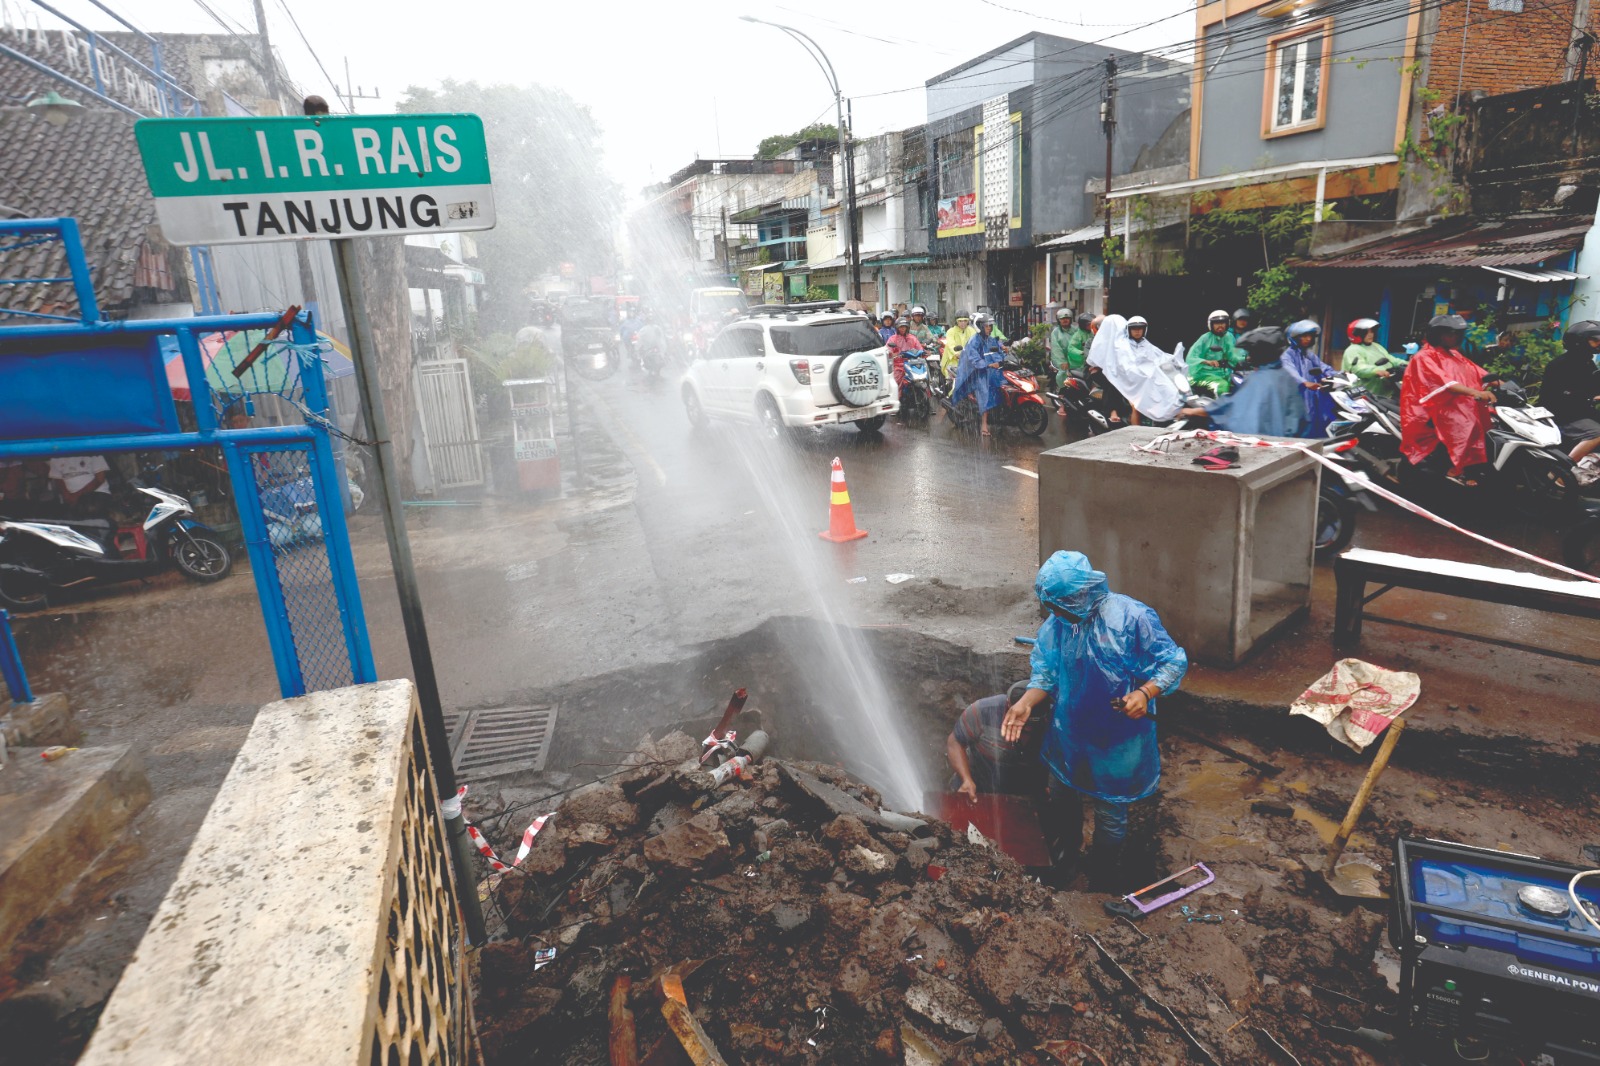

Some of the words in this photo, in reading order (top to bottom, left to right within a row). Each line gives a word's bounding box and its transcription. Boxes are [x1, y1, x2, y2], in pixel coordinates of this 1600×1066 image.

[173, 131, 248, 182] JL.
[255, 130, 289, 178] I.
[293, 129, 344, 177] R.
[352, 125, 462, 173] RAIS
[223, 194, 440, 236] TANJUNG
[848, 373, 879, 386] TERIOS
[522, 440, 550, 450] JUAL
[516, 449, 556, 459] BENSIN
[1520, 968, 1571, 986] GENERAL
